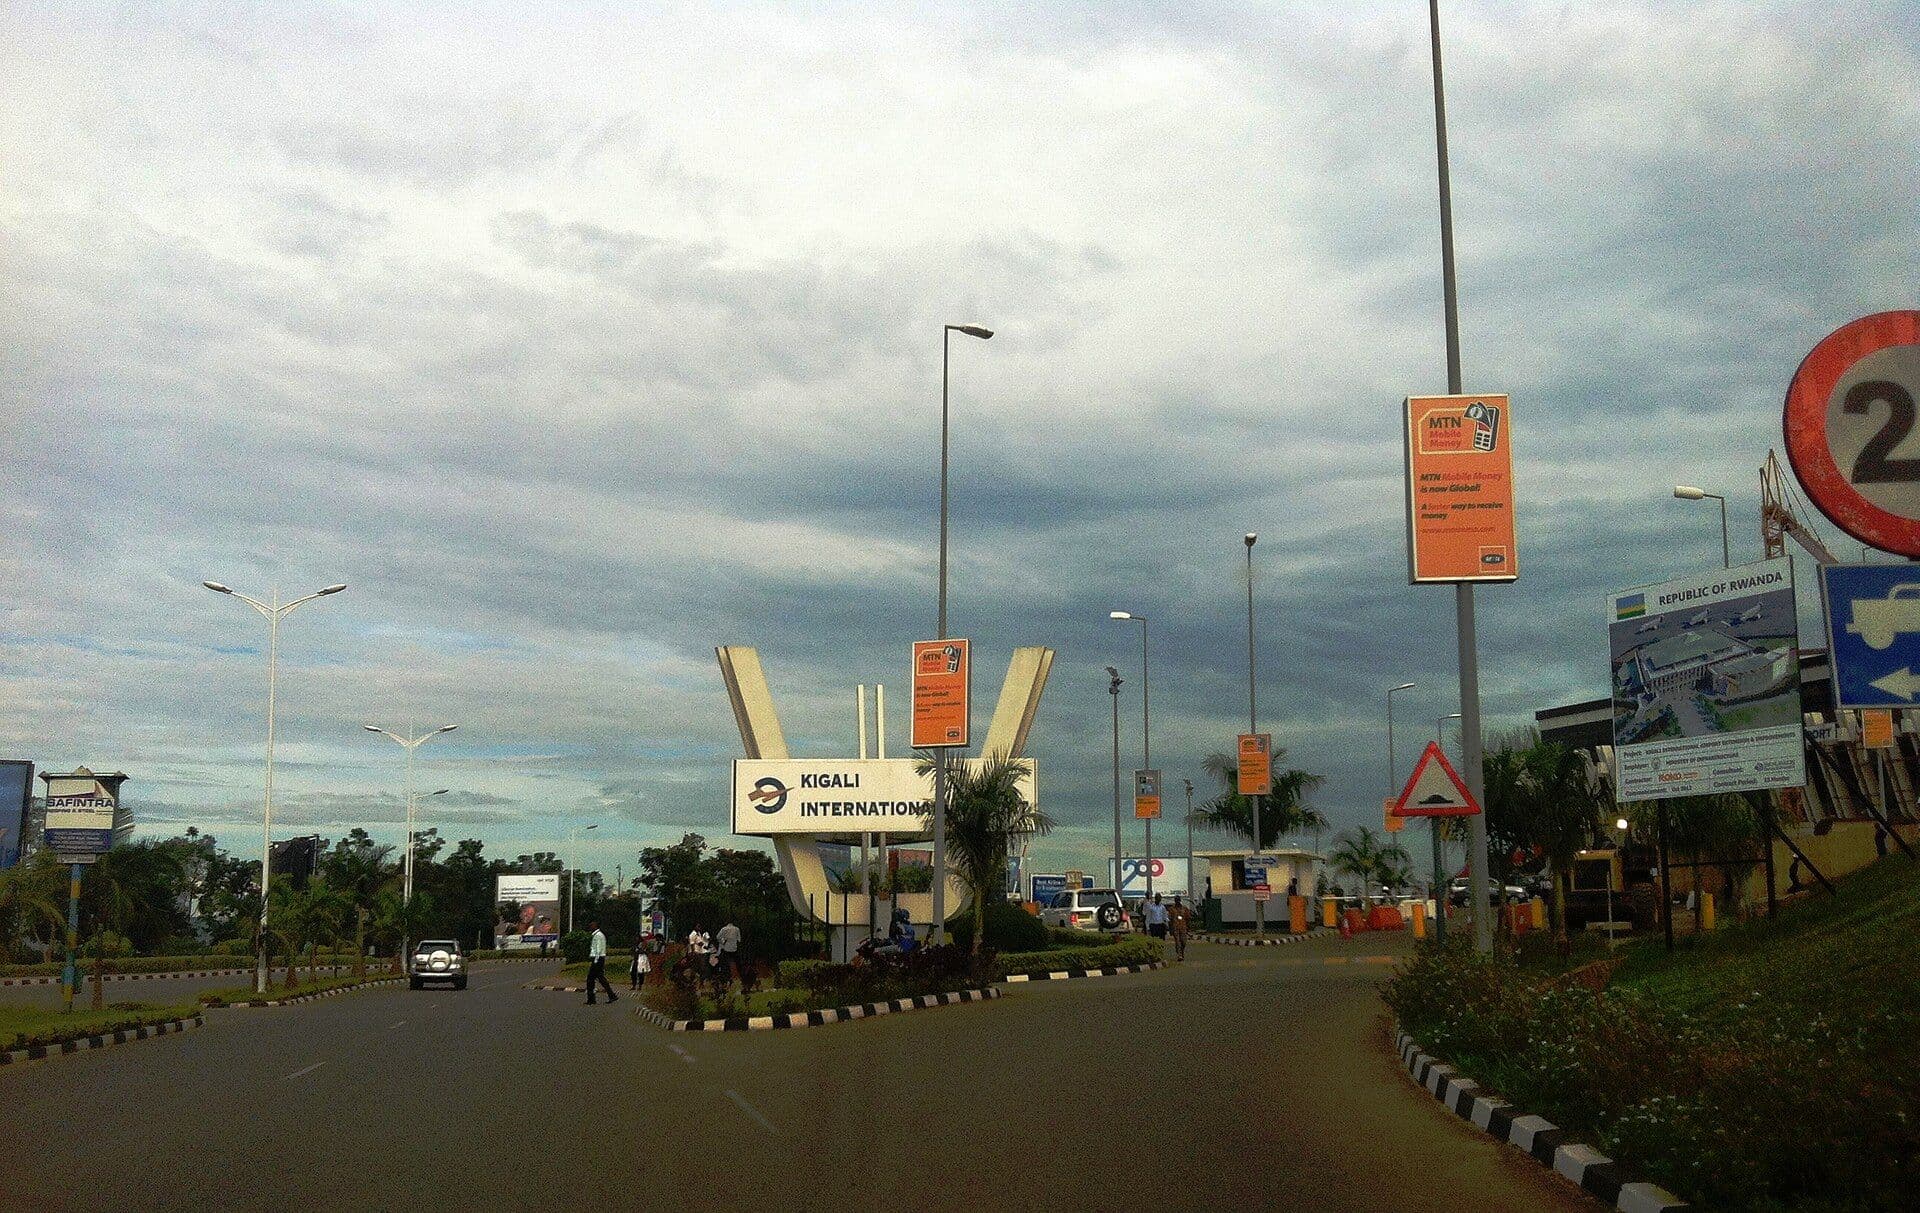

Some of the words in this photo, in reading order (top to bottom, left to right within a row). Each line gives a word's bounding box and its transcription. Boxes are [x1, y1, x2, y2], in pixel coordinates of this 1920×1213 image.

[1429, 417, 1461, 428] MTN
[1430, 430, 1460, 438] Mobile
[1430, 440, 1460, 449] Money
[1451, 502, 1467, 511] way
[1477, 501, 1503, 509] receive
[1659, 587, 1708, 606] REPUBLIC
[1711, 583, 1727, 595] OF
[1730, 571, 1782, 591] RWANDA
[801, 774, 859, 787] KIGALI
[47, 799, 113, 807] SAFINTRA
[801, 802, 936, 816] INTERNATIONA
